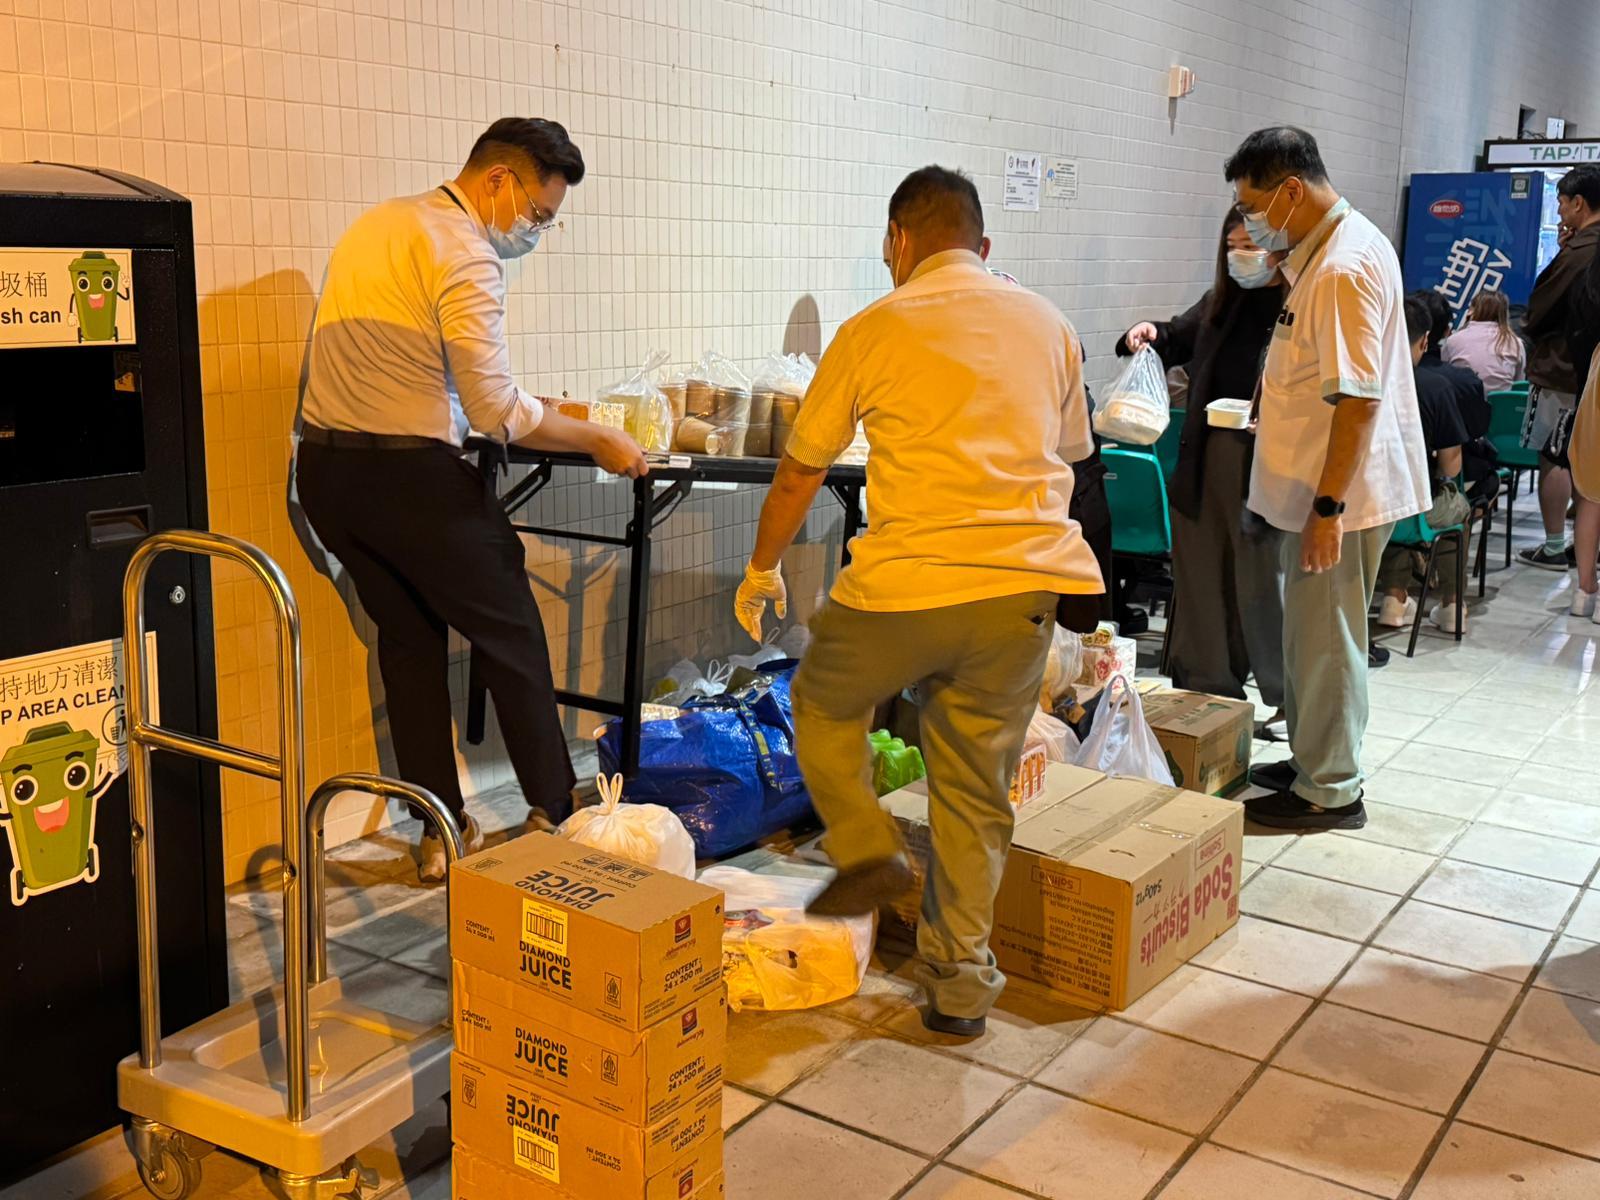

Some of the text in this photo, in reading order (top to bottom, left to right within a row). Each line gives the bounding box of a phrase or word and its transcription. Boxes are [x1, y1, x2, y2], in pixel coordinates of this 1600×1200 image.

[1529, 146, 1579, 160] TAP!
[0, 271, 47, 298] 圾桶
[29, 310, 61, 323] can
[17, 697, 69, 722] AREA
[514, 880, 593, 911] DIAMOND
[525, 869, 616, 903] JUICE
[1194, 852, 1233, 920] Soda
[1140, 894, 1190, 967] Biscuits
[519, 940, 571, 968] DIAMOND
[519, 954, 572, 990] JUICE
[664, 957, 699, 982] CONTENT
[680, 970, 694, 984] 200
[515, 1027, 568, 1056] DIAMOND
[514, 1041, 569, 1078] JUICE
[669, 1056, 701, 1082] CONTENT
[505, 1093, 560, 1132] JUICE
[506, 1115, 559, 1145] DIAMOND
[674, 1124, 705, 1153] CONTENT
[591, 1155, 621, 1172] CONTENT
